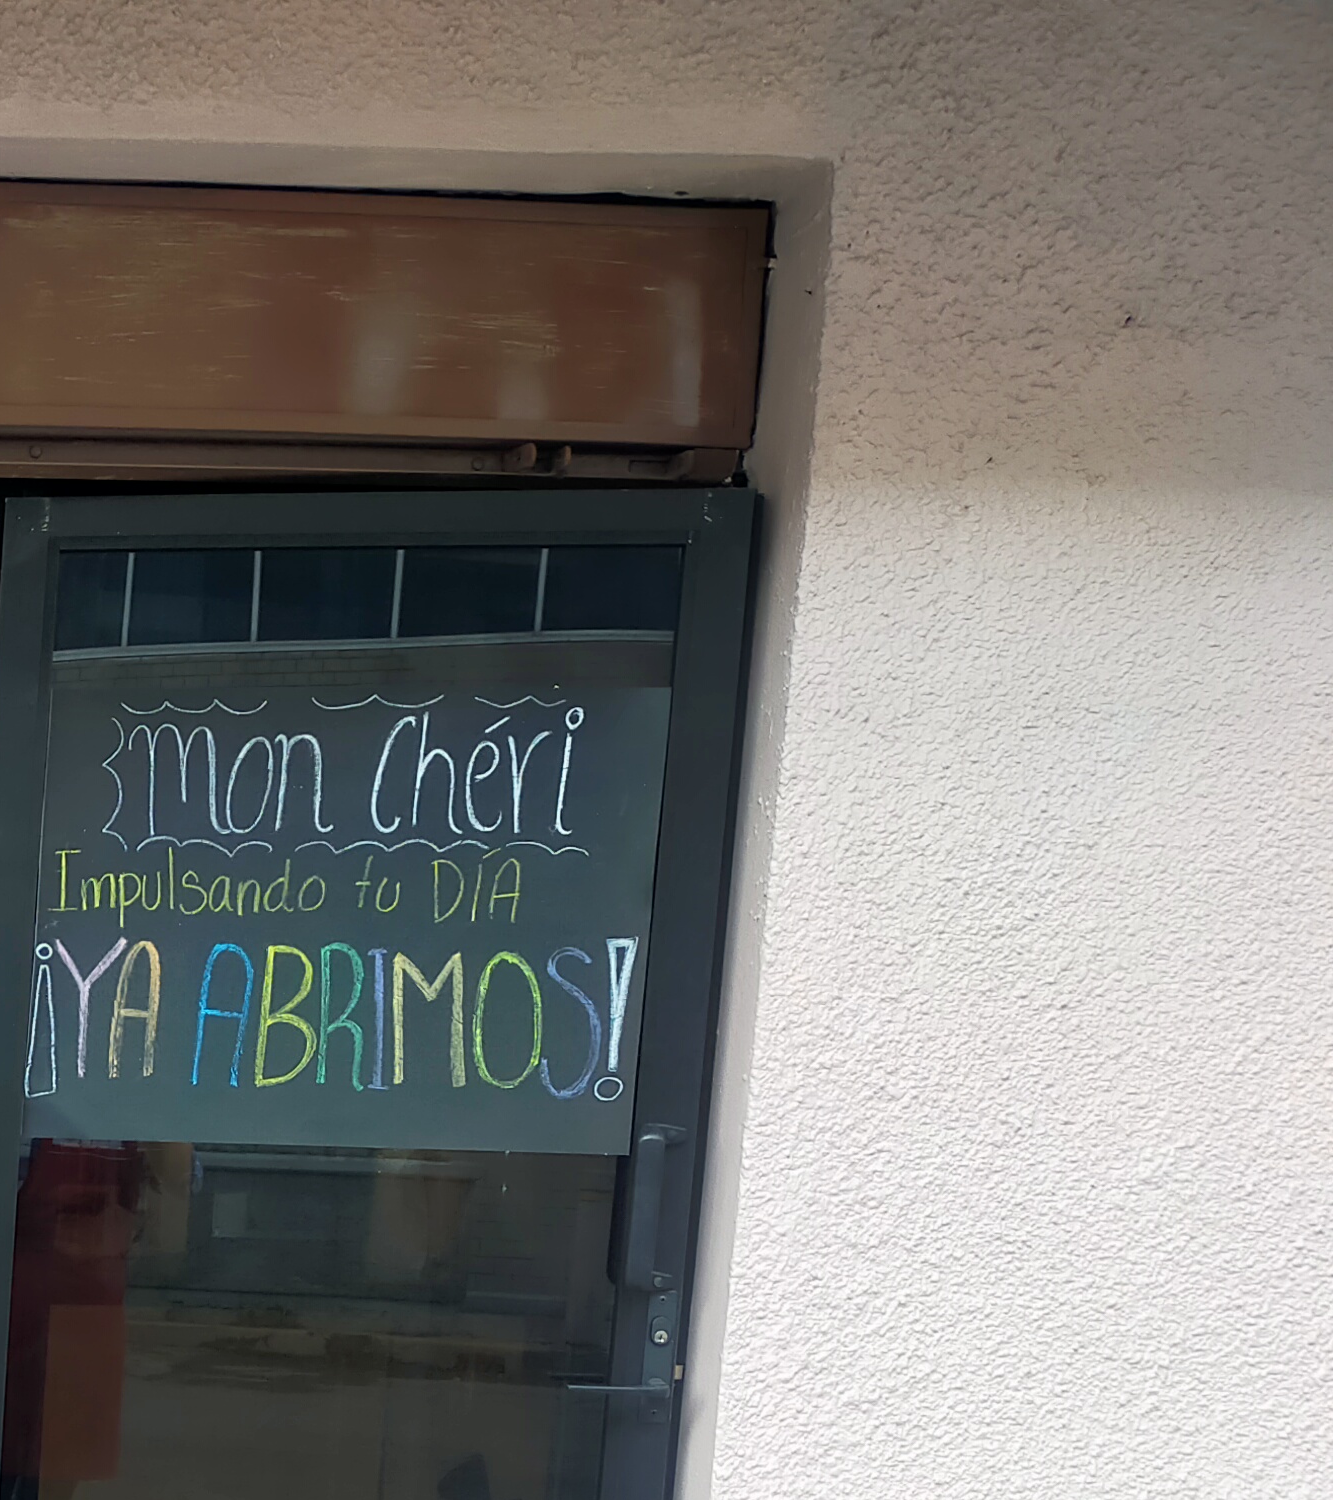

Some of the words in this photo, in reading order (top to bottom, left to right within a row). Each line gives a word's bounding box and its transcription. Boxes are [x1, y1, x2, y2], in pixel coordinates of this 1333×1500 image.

[370, 706, 585, 836] Chéri
[47, 846, 326, 928] Impulsando
[353, 855, 401, 913] tu
[432, 847, 522, 924] DÍA
[24, 936, 162, 1099] ¡YA
[190, 936, 639, 1102] ABRIMOS!
